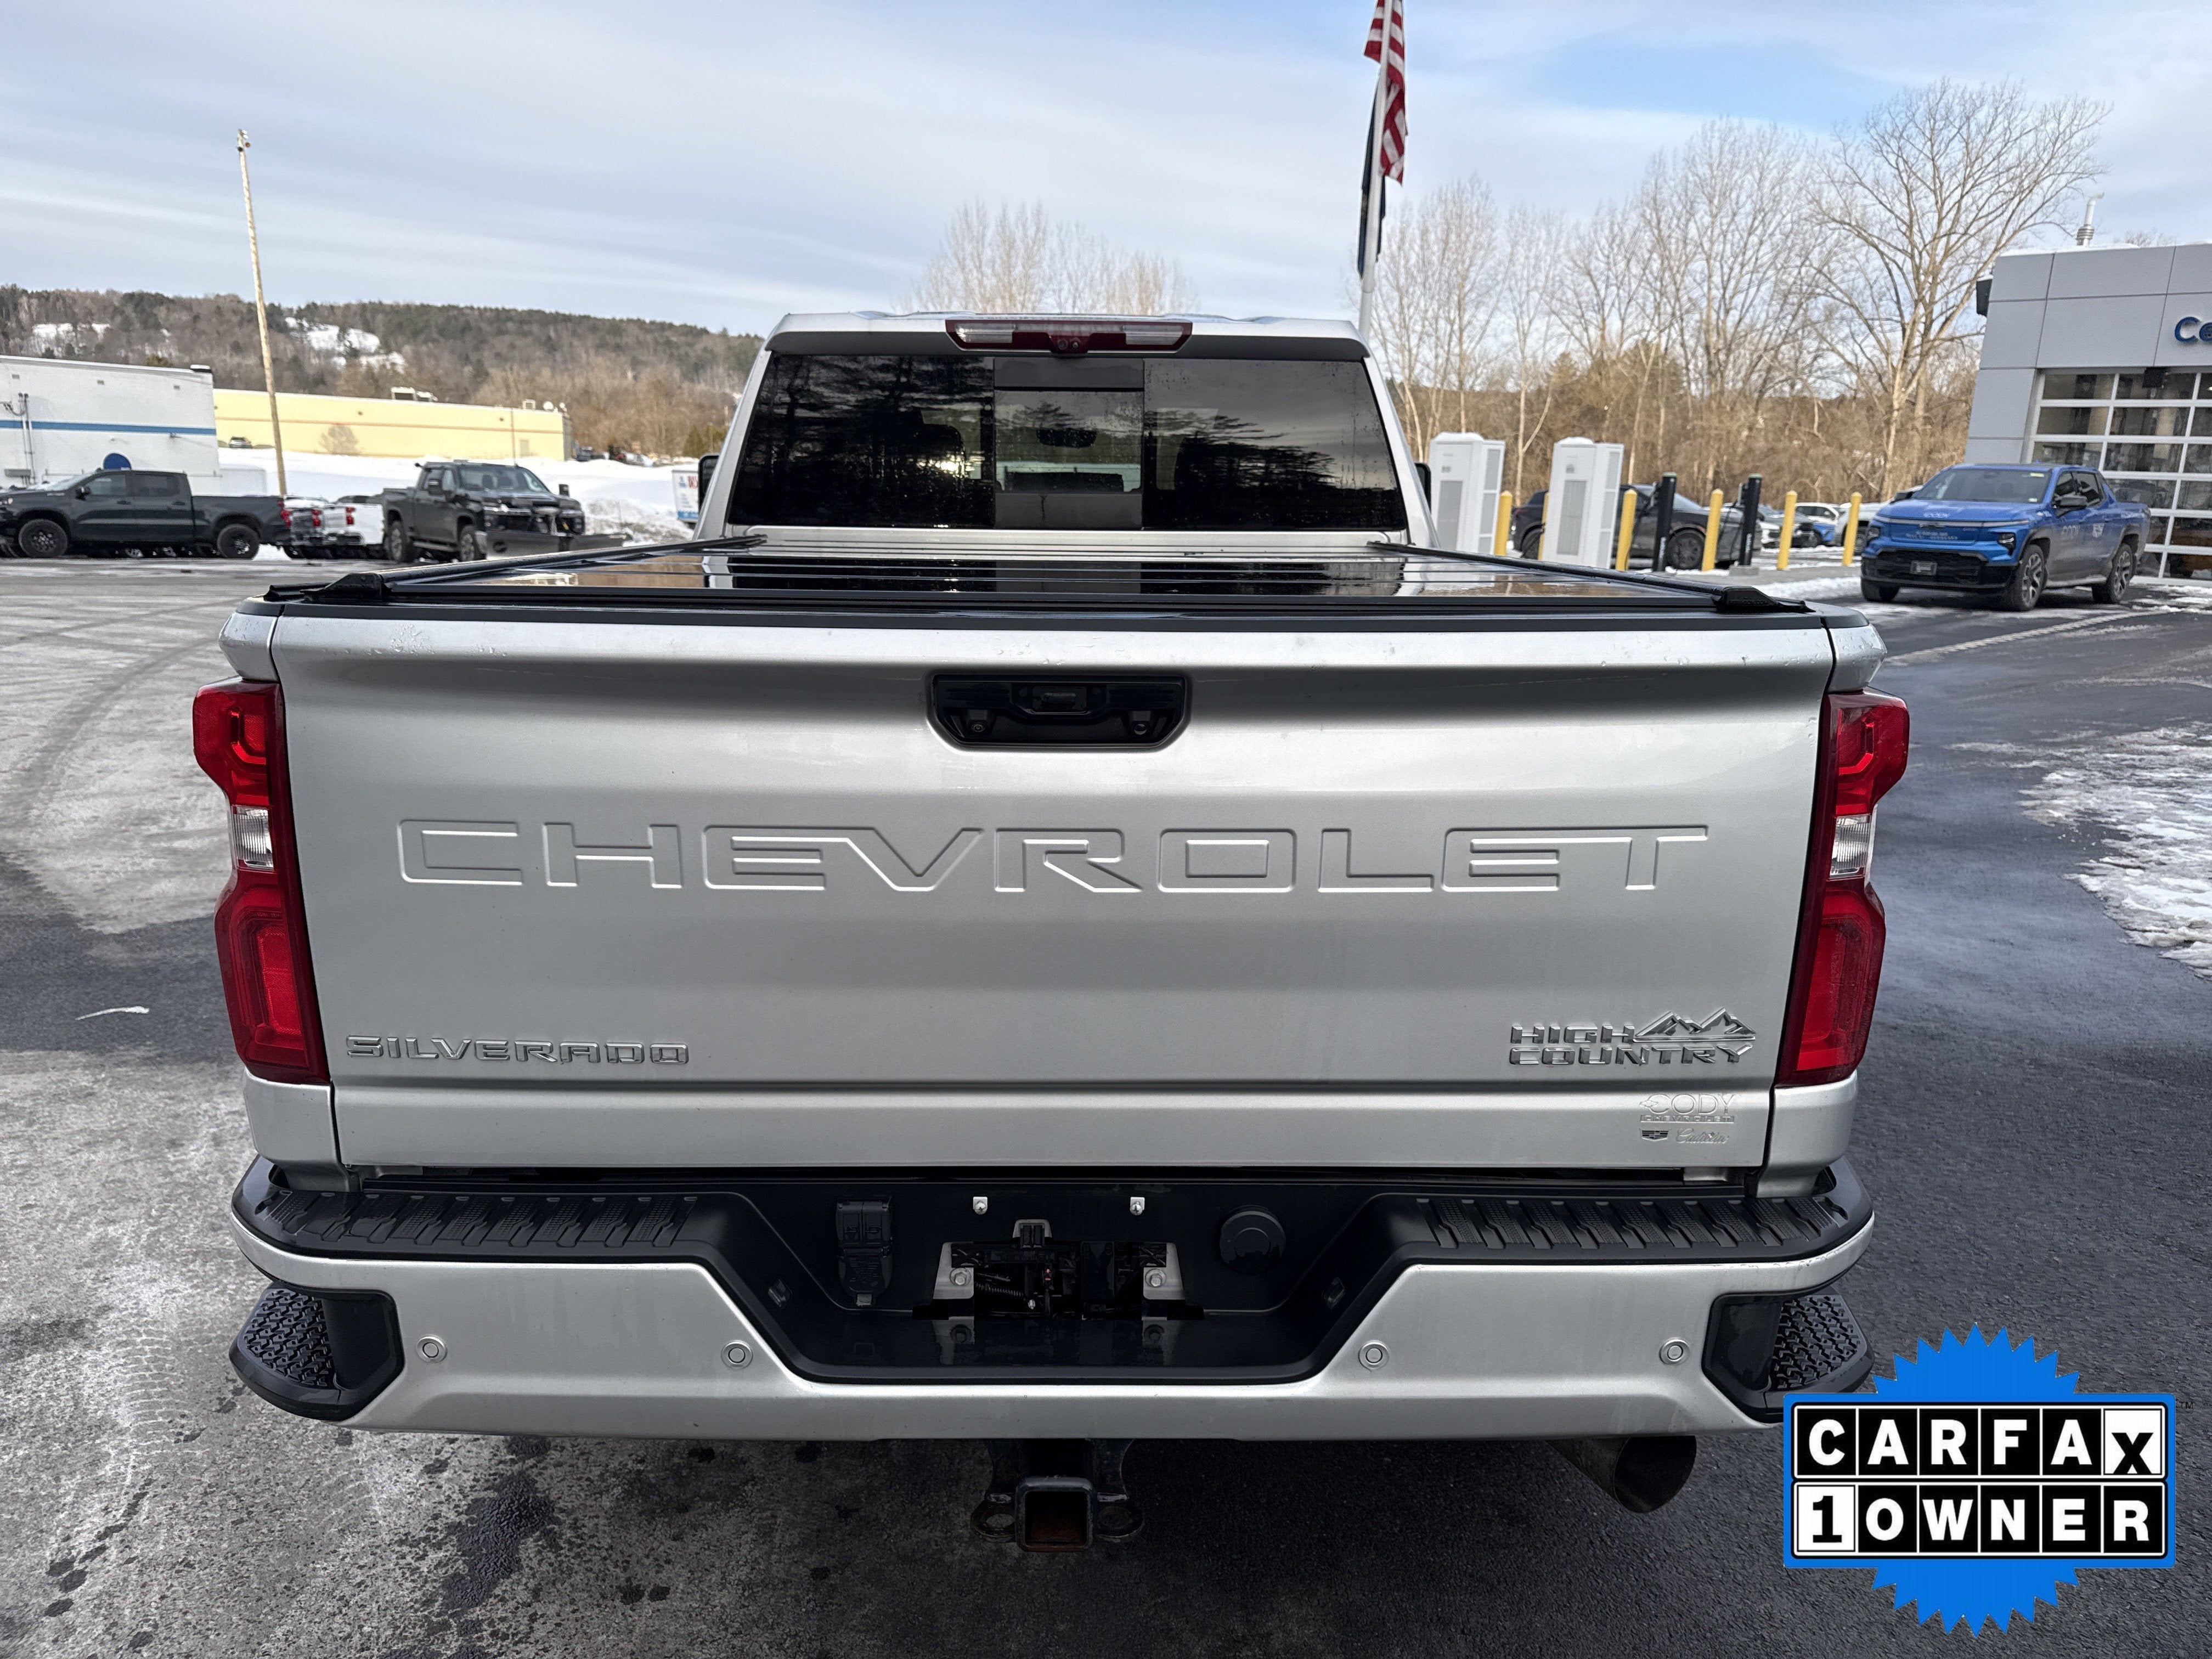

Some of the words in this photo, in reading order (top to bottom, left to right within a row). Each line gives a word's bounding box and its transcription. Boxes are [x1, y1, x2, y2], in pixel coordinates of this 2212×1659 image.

[397, 819, 1708, 893] CHEVROLET
[1510, 1025, 1635, 1044] HIGH
[346, 1035, 689, 1064] SILVERADO
[1509, 1043, 1753, 1065] COUNTRY
[1645, 1094, 1736, 1115] CODY
